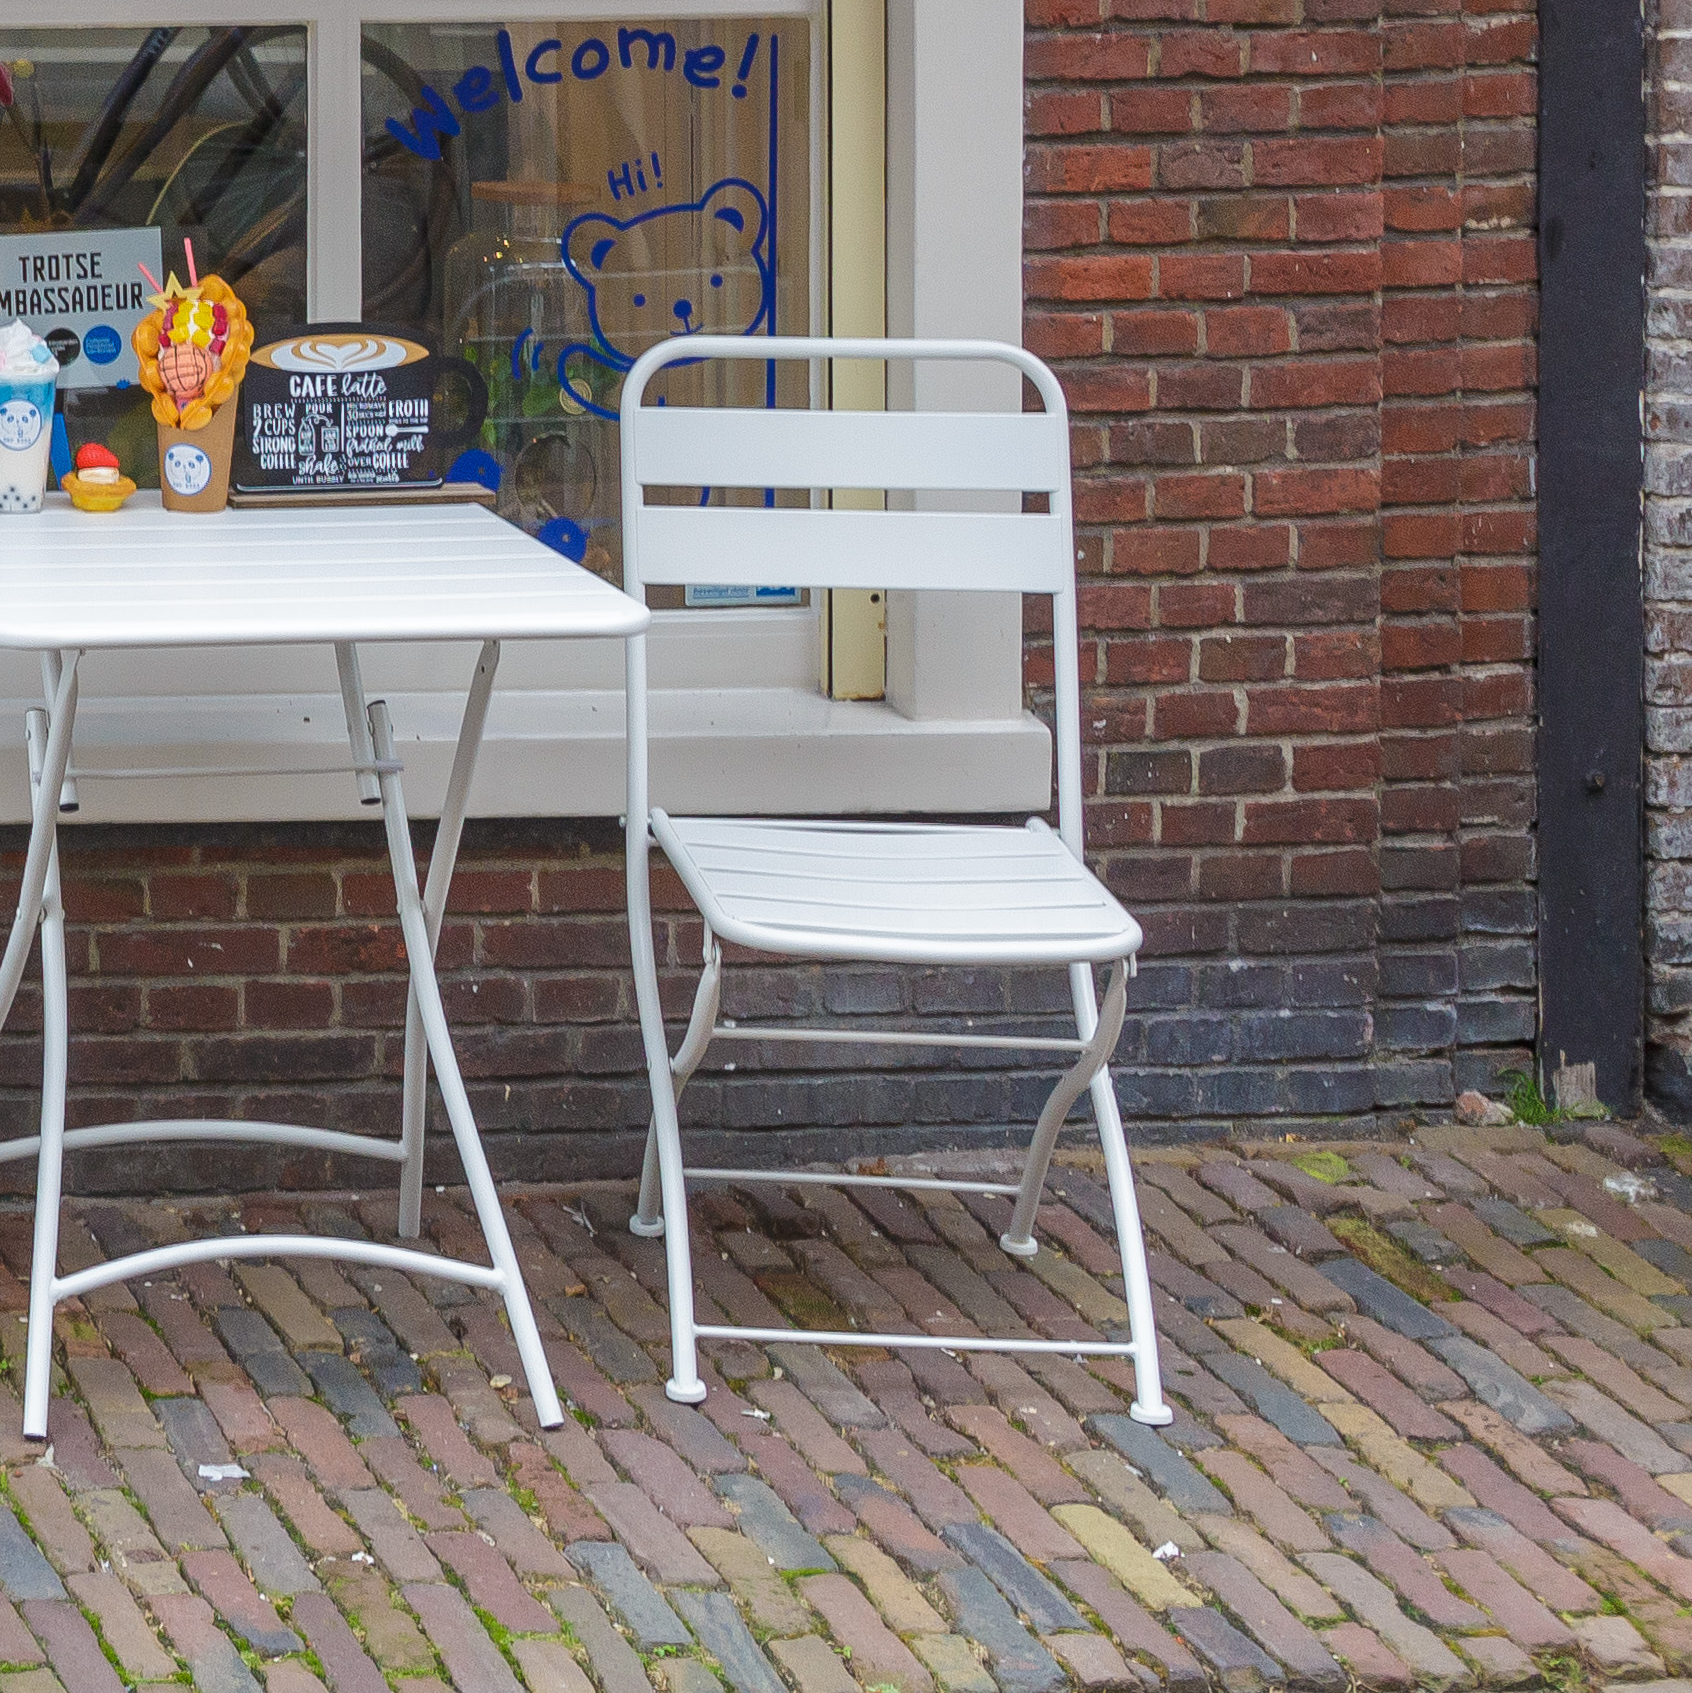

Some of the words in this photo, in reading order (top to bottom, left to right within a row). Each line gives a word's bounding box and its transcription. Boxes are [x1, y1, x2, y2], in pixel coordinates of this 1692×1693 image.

[384, 26, 760, 161] Welcome!
[607, 152, 666, 201] Hi!
[18, 251, 103, 283] TROTSE
[289, 374, 338, 397] CAFE
[341, 372, 387, 398] latte
[253, 402, 296, 419] BREW
[305, 402, 333, 414] POUR
[388, 398, 429, 418] FROTH
[264, 418, 296, 436] CUPS
[346, 424, 384, 438] SPOON
